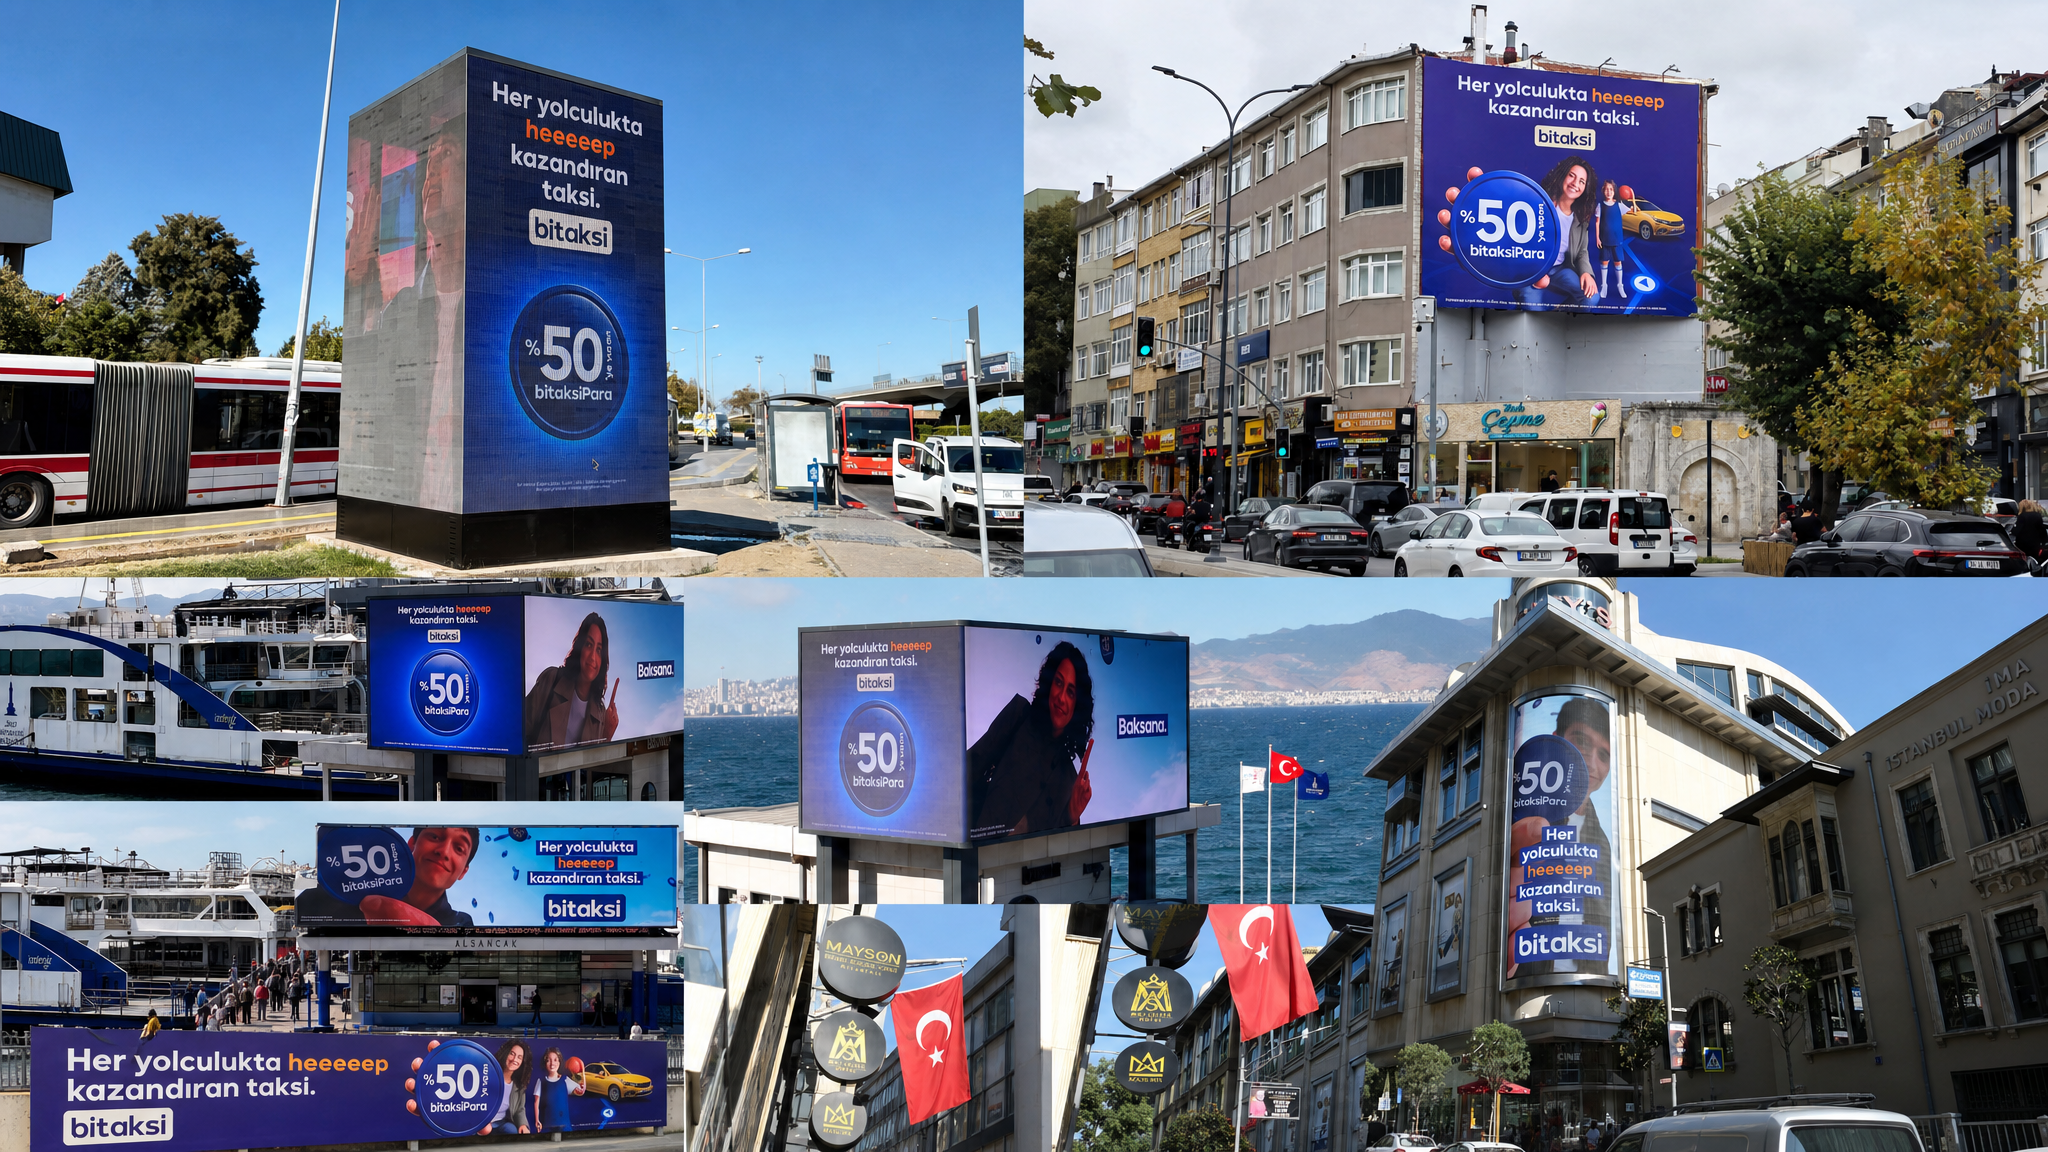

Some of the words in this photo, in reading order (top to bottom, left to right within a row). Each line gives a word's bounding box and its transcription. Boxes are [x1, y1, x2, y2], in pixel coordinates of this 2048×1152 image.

[1457, 75, 1490, 93] Her
[1494, 80, 1588, 102] yolculukta
[1592, 87, 1665, 111] heeeeep
[492, 81, 532, 109] Her
[537, 96, 643, 136] yolculukta
[1488, 99, 1588, 122] kazandıran
[1592, 109, 1640, 126] taksi.
[525, 119, 615, 159] heeeeep
[1538, 129, 1592, 147] bitaksi
[511, 143, 628, 186] kazandıran
[542, 180, 600, 208] taksi.
[1460, 198, 1536, 244] %50
[534, 216, 608, 249] bitaksi
[1470, 244, 1545, 260] bitaksiPara
[525, 324, 603, 383] %50
[535, 384, 612, 401] bitaksiPara
[397, 606, 411, 614] Her
[413, 605, 454, 616] yolculukta
[456, 614, 479, 624] taksi.
[429, 631, 459, 641] bitaksi
[821, 643, 838, 655] Her
[839, 642, 888, 656] yolculukta
[834, 656, 888, 668] kazandıran
[890, 654, 918, 667] taksi.
[419, 673, 464, 705] %50
[859, 676, 892, 689] bitaksi
[424, 706, 469, 716] bitaksiPara
[1975, 681, 2038, 726] MODA
[1118, 717, 1167, 736] Baksana.
[847, 732, 898, 774] %50
[853, 775, 904, 788] bitaksiPara
[1513, 761, 1564, 795] %50
[1513, 795, 1567, 808] bitaksiPara
[1546, 828, 1573, 841] Her
[539, 841, 562, 854] Her
[565, 841, 635, 855] yolculukta
[1521, 844, 1598, 864] yolculukta
[326, 844, 390, 878] %50
[558, 857, 615, 871] heeeeep
[529, 871, 603, 885] kazandıran
[605, 871, 642, 885] taksi.
[1527, 864, 1593, 878] heeeeep
[341, 877, 403, 894] bitaksiPara
[1519, 881, 1601, 898] kazandıran
[548, 898, 621, 919] bitaksi
[1536, 898, 1580, 913] taksi.
[455, 939, 517, 948] ALSANCAK
[826, 939, 901, 965] MAYSON
[1518, 931, 1603, 956] bitaksi
[67, 1048, 126, 1072] Her
[134, 1050, 281, 1077] yolculukta
[288, 1053, 389, 1076] heeeeep
[67, 1078, 239, 1102] kazandıran
[246, 1076, 316, 1097] taksi.
[423, 1064, 480, 1100] %50
[430, 1101, 487, 1112] bitaksiPara
[70, 1114, 167, 1138] bitaksi
